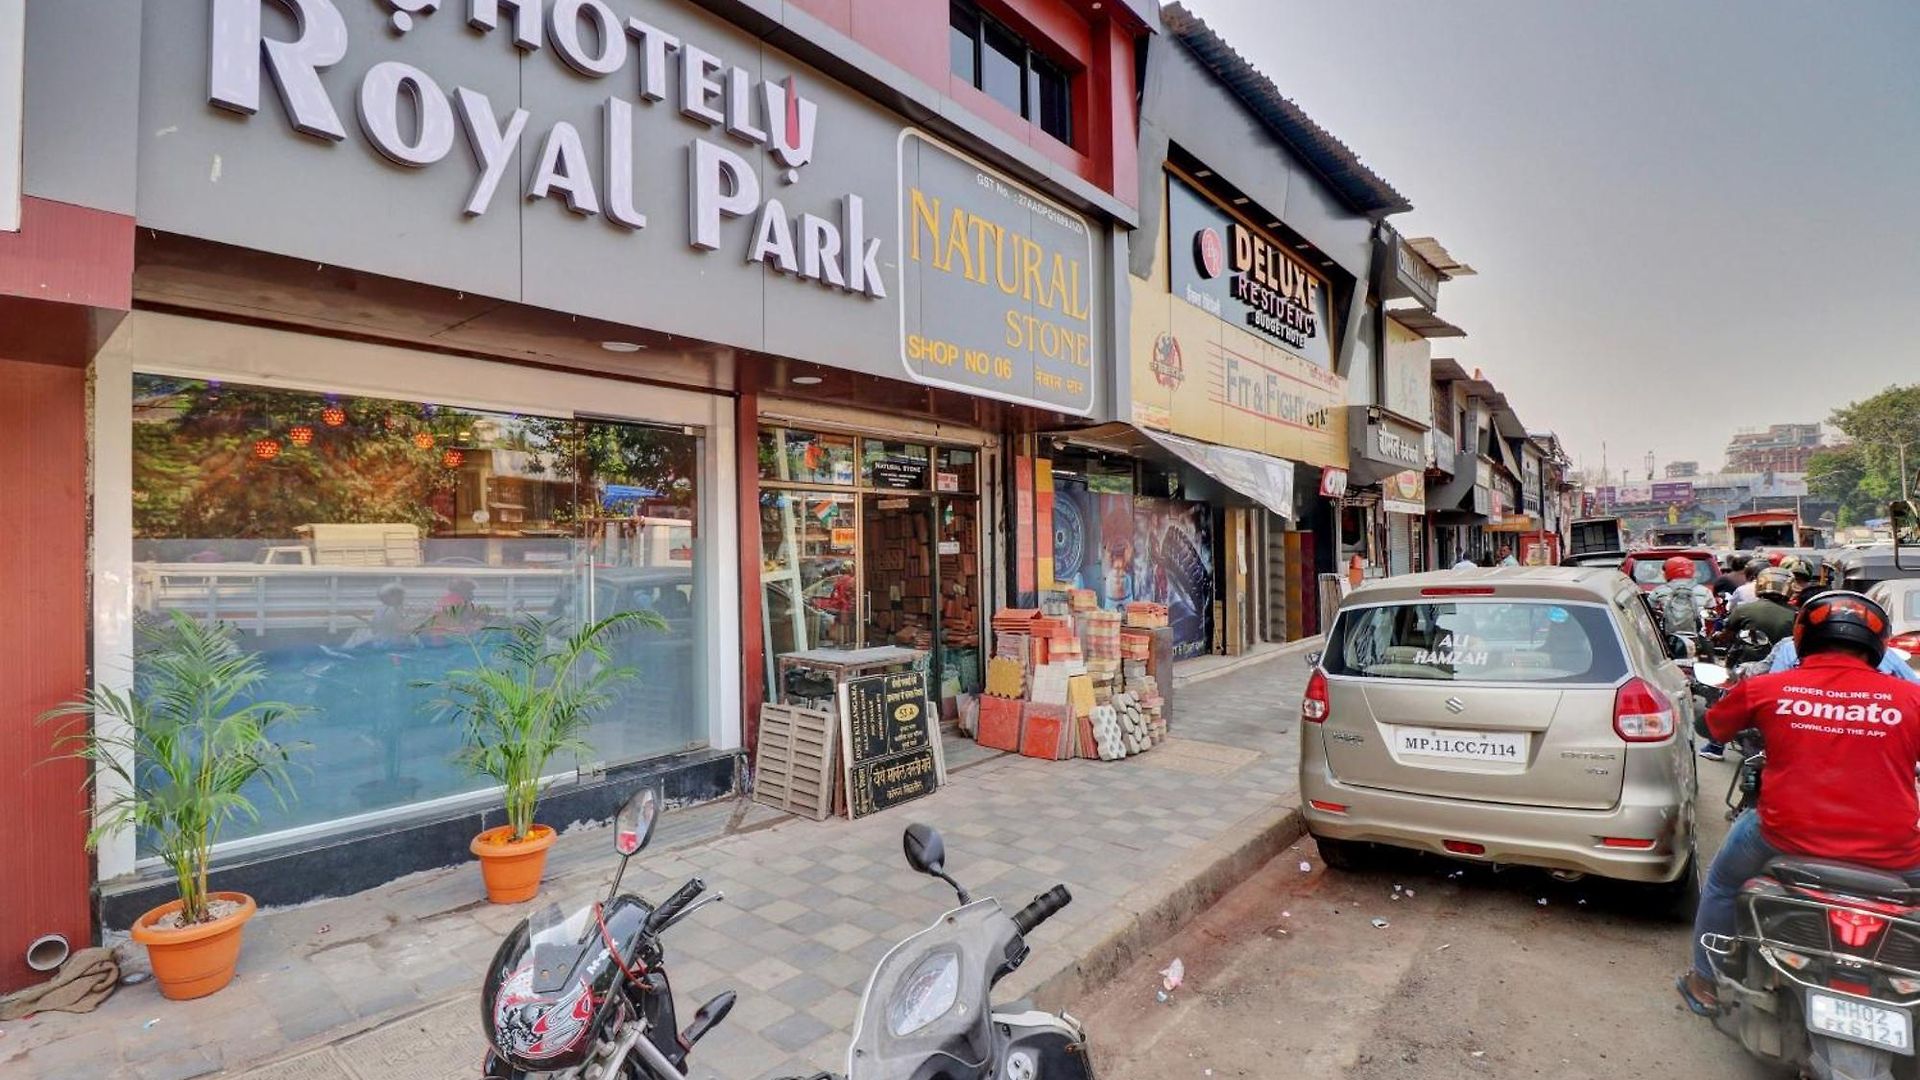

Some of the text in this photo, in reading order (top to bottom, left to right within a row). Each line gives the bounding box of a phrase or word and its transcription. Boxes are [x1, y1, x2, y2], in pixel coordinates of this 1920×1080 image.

[977, 173, 994, 189] GST
[907, 186, 1090, 321] NATURAL
[1234, 223, 1318, 314] DELUXE
[1005, 309, 1090, 368] STONE
[1255, 310, 1307, 349] BUDGET HOTE
[907, 334, 1013, 381] SHOP NO 06
[1227, 358, 1251, 408] FIT
[1253, 382, 1264, 412] &
[1266, 374, 1304, 424] FIGHT
[875, 462, 902, 472] NATURAL
[1438, 634, 1470, 648] ALI
[1412, 651, 1489, 666] HAMZAH
[1783, 685, 1893, 701] ORDER ONLINE ON
[1775, 698, 1903, 726] zomato
[1790, 722, 1887, 738] DOWNLOAD THE APP
[1405, 737, 1516, 757] MP.11.CC.7114
[1835, 999, 1888, 1026] MH02
